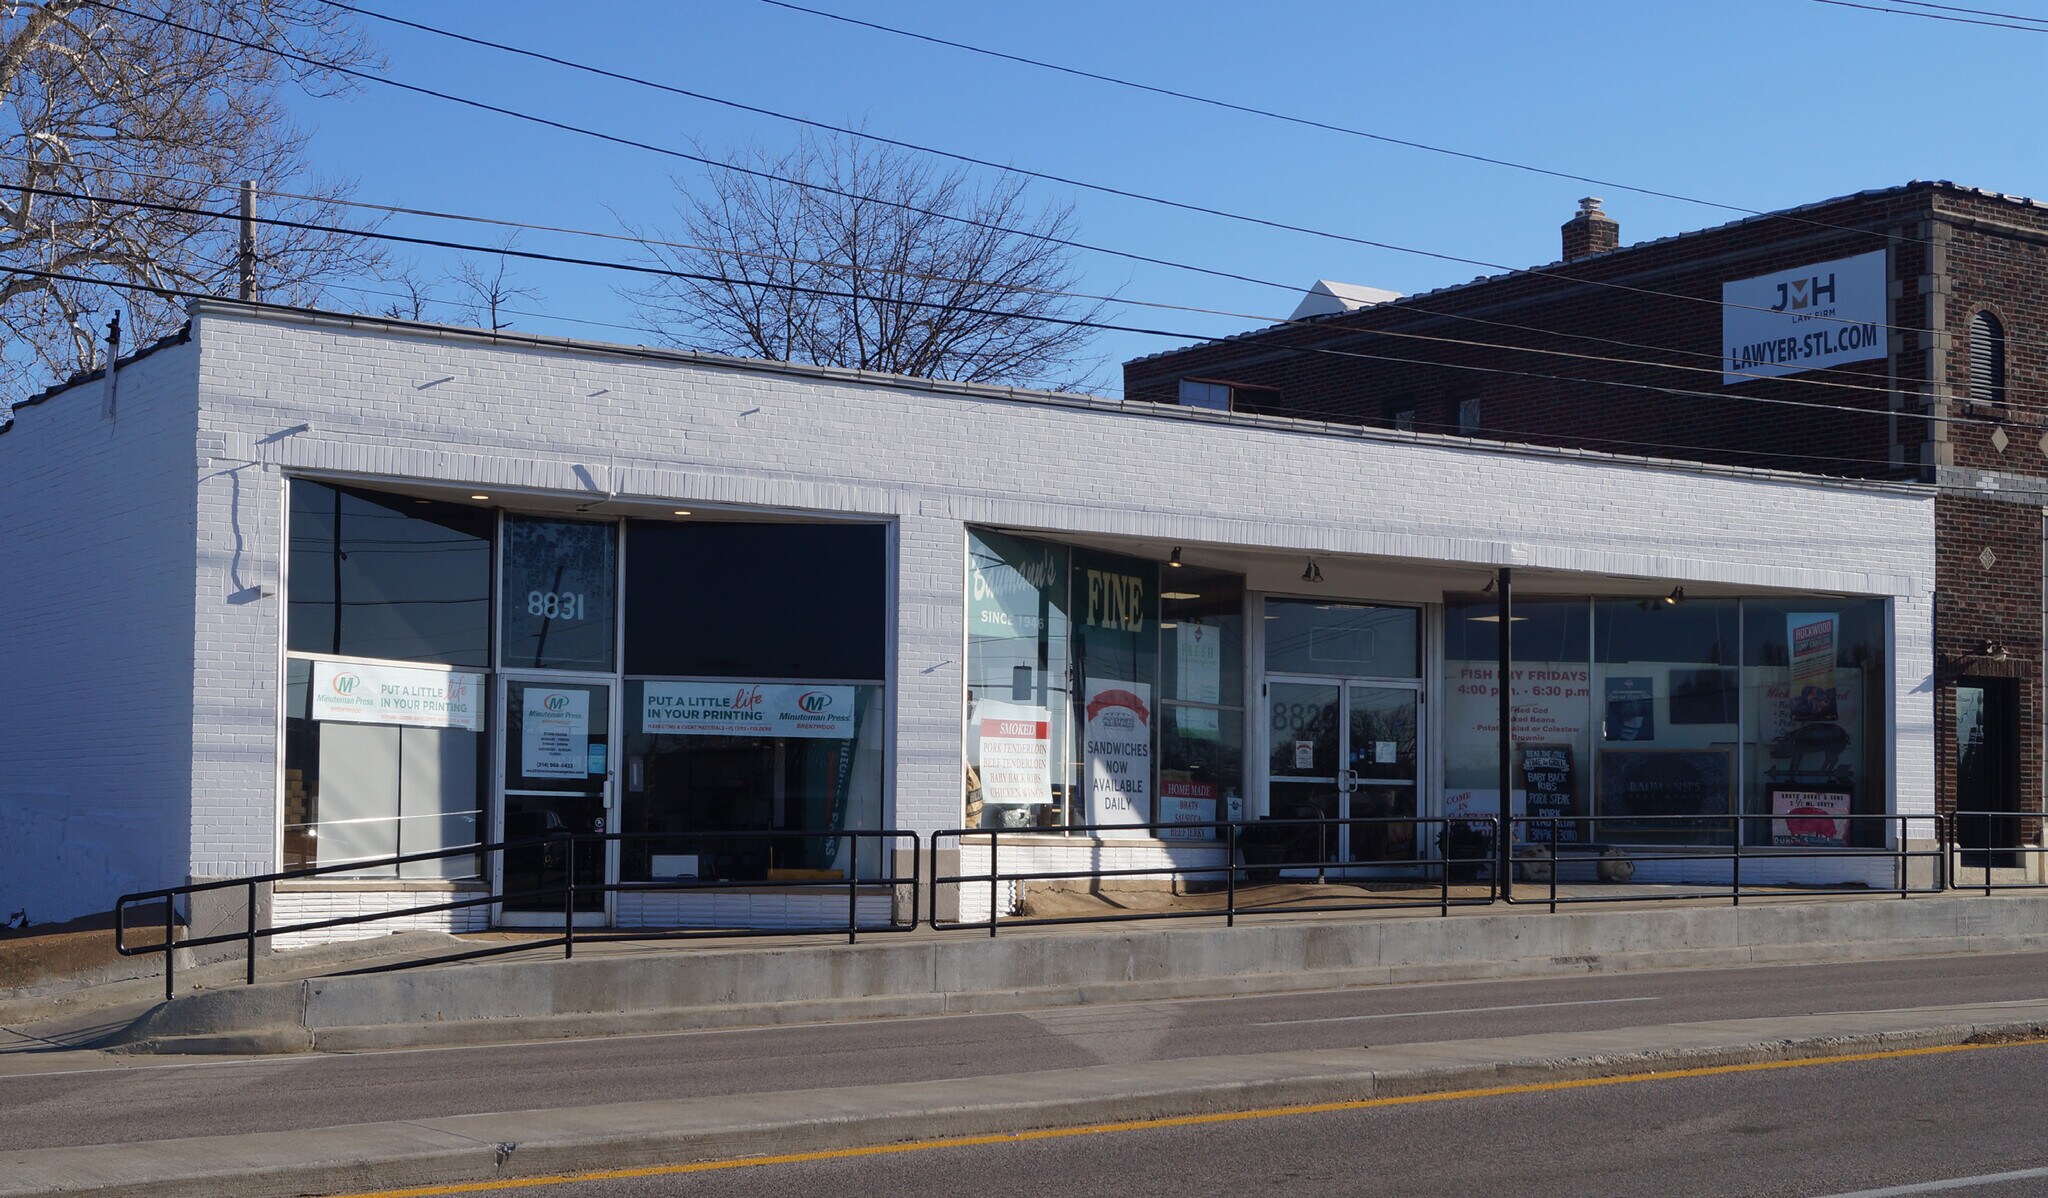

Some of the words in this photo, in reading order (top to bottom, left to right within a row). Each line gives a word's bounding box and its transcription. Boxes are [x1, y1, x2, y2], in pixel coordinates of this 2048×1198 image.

[1792, 313, 1812, 324] LAW
[1815, 308, 1836, 321] FIRM
[1732, 322, 1877, 370] LAWYER-STL.COM
[527, 590, 584, 620] 8831
[1086, 568, 1144, 633] FINE
[981, 610, 1013, 626] SINCE
[1018, 616, 1044, 629] 1946
[1795, 621, 1832, 640] ROCKWOOD
[1181, 643, 1214, 659] FRESH
[1460, 669, 1492, 680] FISH
[1528, 671, 1587, 681] FRIDAYS
[381, 684, 400, 695] PUT
[402, 685, 410, 695] A
[412, 687, 443, 698] LITTLE
[444, 675, 467, 703] life
[1457, 684, 1487, 695] 4:00
[1532, 686, 1561, 696] 6:30
[316, 694, 355, 705] Minuteman
[355, 696, 374, 706] Press
[648, 696, 673, 706] PUT
[676, 697, 685, 706] A
[689, 697, 730, 708] LITTLE
[731, 685, 763, 711] life
[381, 699, 391, 709] IN
[393, 699, 421, 710] YOUR
[423, 701, 467, 713] PRINTING
[528, 710, 565, 718] Minuteman
[565, 711, 581, 719] Press
[648, 709, 661, 719] IN
[664, 710, 699, 720] YOUR
[703, 710, 763, 721] PRINTING
[779, 712, 825, 721] Minuteman
[827, 714, 850, 722] Press
[999, 722, 1036, 736] SMOKED
[1477, 724, 1500, 732] Potat
[1542, 725, 1579, 733] Coleslaw
[983, 742, 1002, 753] PORK
[1004, 743, 1047, 754] TENDERLOIN
[1087, 740, 1148, 757] SANDWICHES
[983, 757, 1000, 768] BEEF
[1002, 758, 1047, 769] TENDERLOIN
[1105, 760, 1128, 774] NOW
[990, 773, 1007, 783] BABY
[1008, 773, 1026, 784] BACK
[1027, 774, 1041, 784] RIBS
[1528, 772, 1546, 783] BABY
[1547, 773, 1567, 783] BACK
[1093, 777, 1143, 793] AVAILABLE
[1168, 783, 1190, 795] HOME
[1190, 784, 1211, 796] MADE
[1537, 782, 1557, 791] RIBS
[1629, 781, 1700, 792] BAUMNN'S
[990, 788, 1020, 798] CHICKEN
[1021, 788, 1044, 798] WINGS
[1446, 791, 1472, 806] COME
[1528, 793, 1549, 805] PORK
[1550, 793, 1571, 805] STEAK
[1105, 797, 1132, 810] DAILY
[1179, 801, 1198, 811] BRATS
[1458, 802, 1468, 811] IN
[1538, 808, 1561, 817] PORK
[1170, 827, 1186, 836] BEEF
